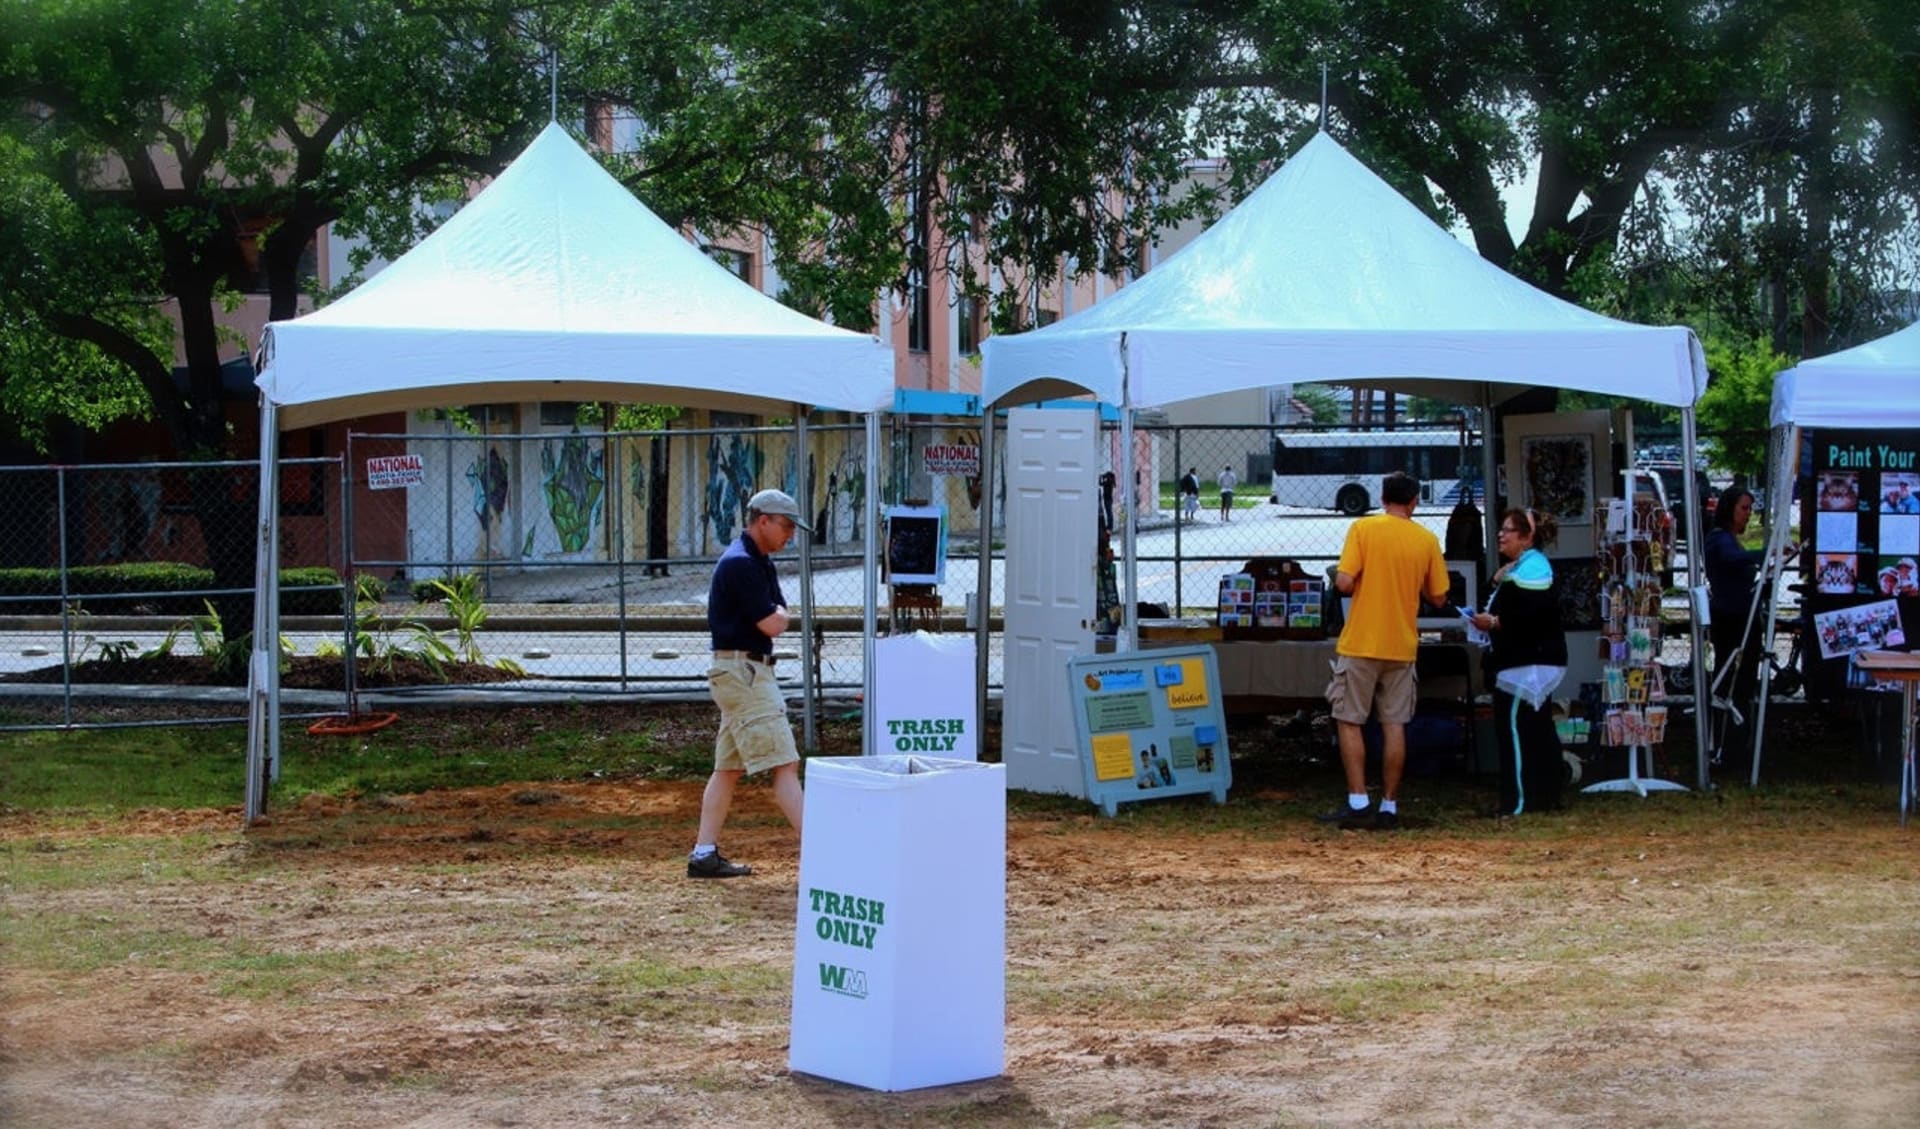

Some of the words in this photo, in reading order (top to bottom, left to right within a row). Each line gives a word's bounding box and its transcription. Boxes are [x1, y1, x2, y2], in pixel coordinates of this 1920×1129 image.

[925, 446, 978, 460] NATIONAL
[1828, 445, 1872, 467] Paint
[1878, 445, 1916, 467] Your
[369, 456, 422, 473] NATIONAL
[887, 719, 964, 735] TRASH
[896, 736, 957, 751] ONLY
[809, 888, 885, 925] TRASH
[816, 916, 877, 950] ONLY
[819, 963, 869, 995] WM
